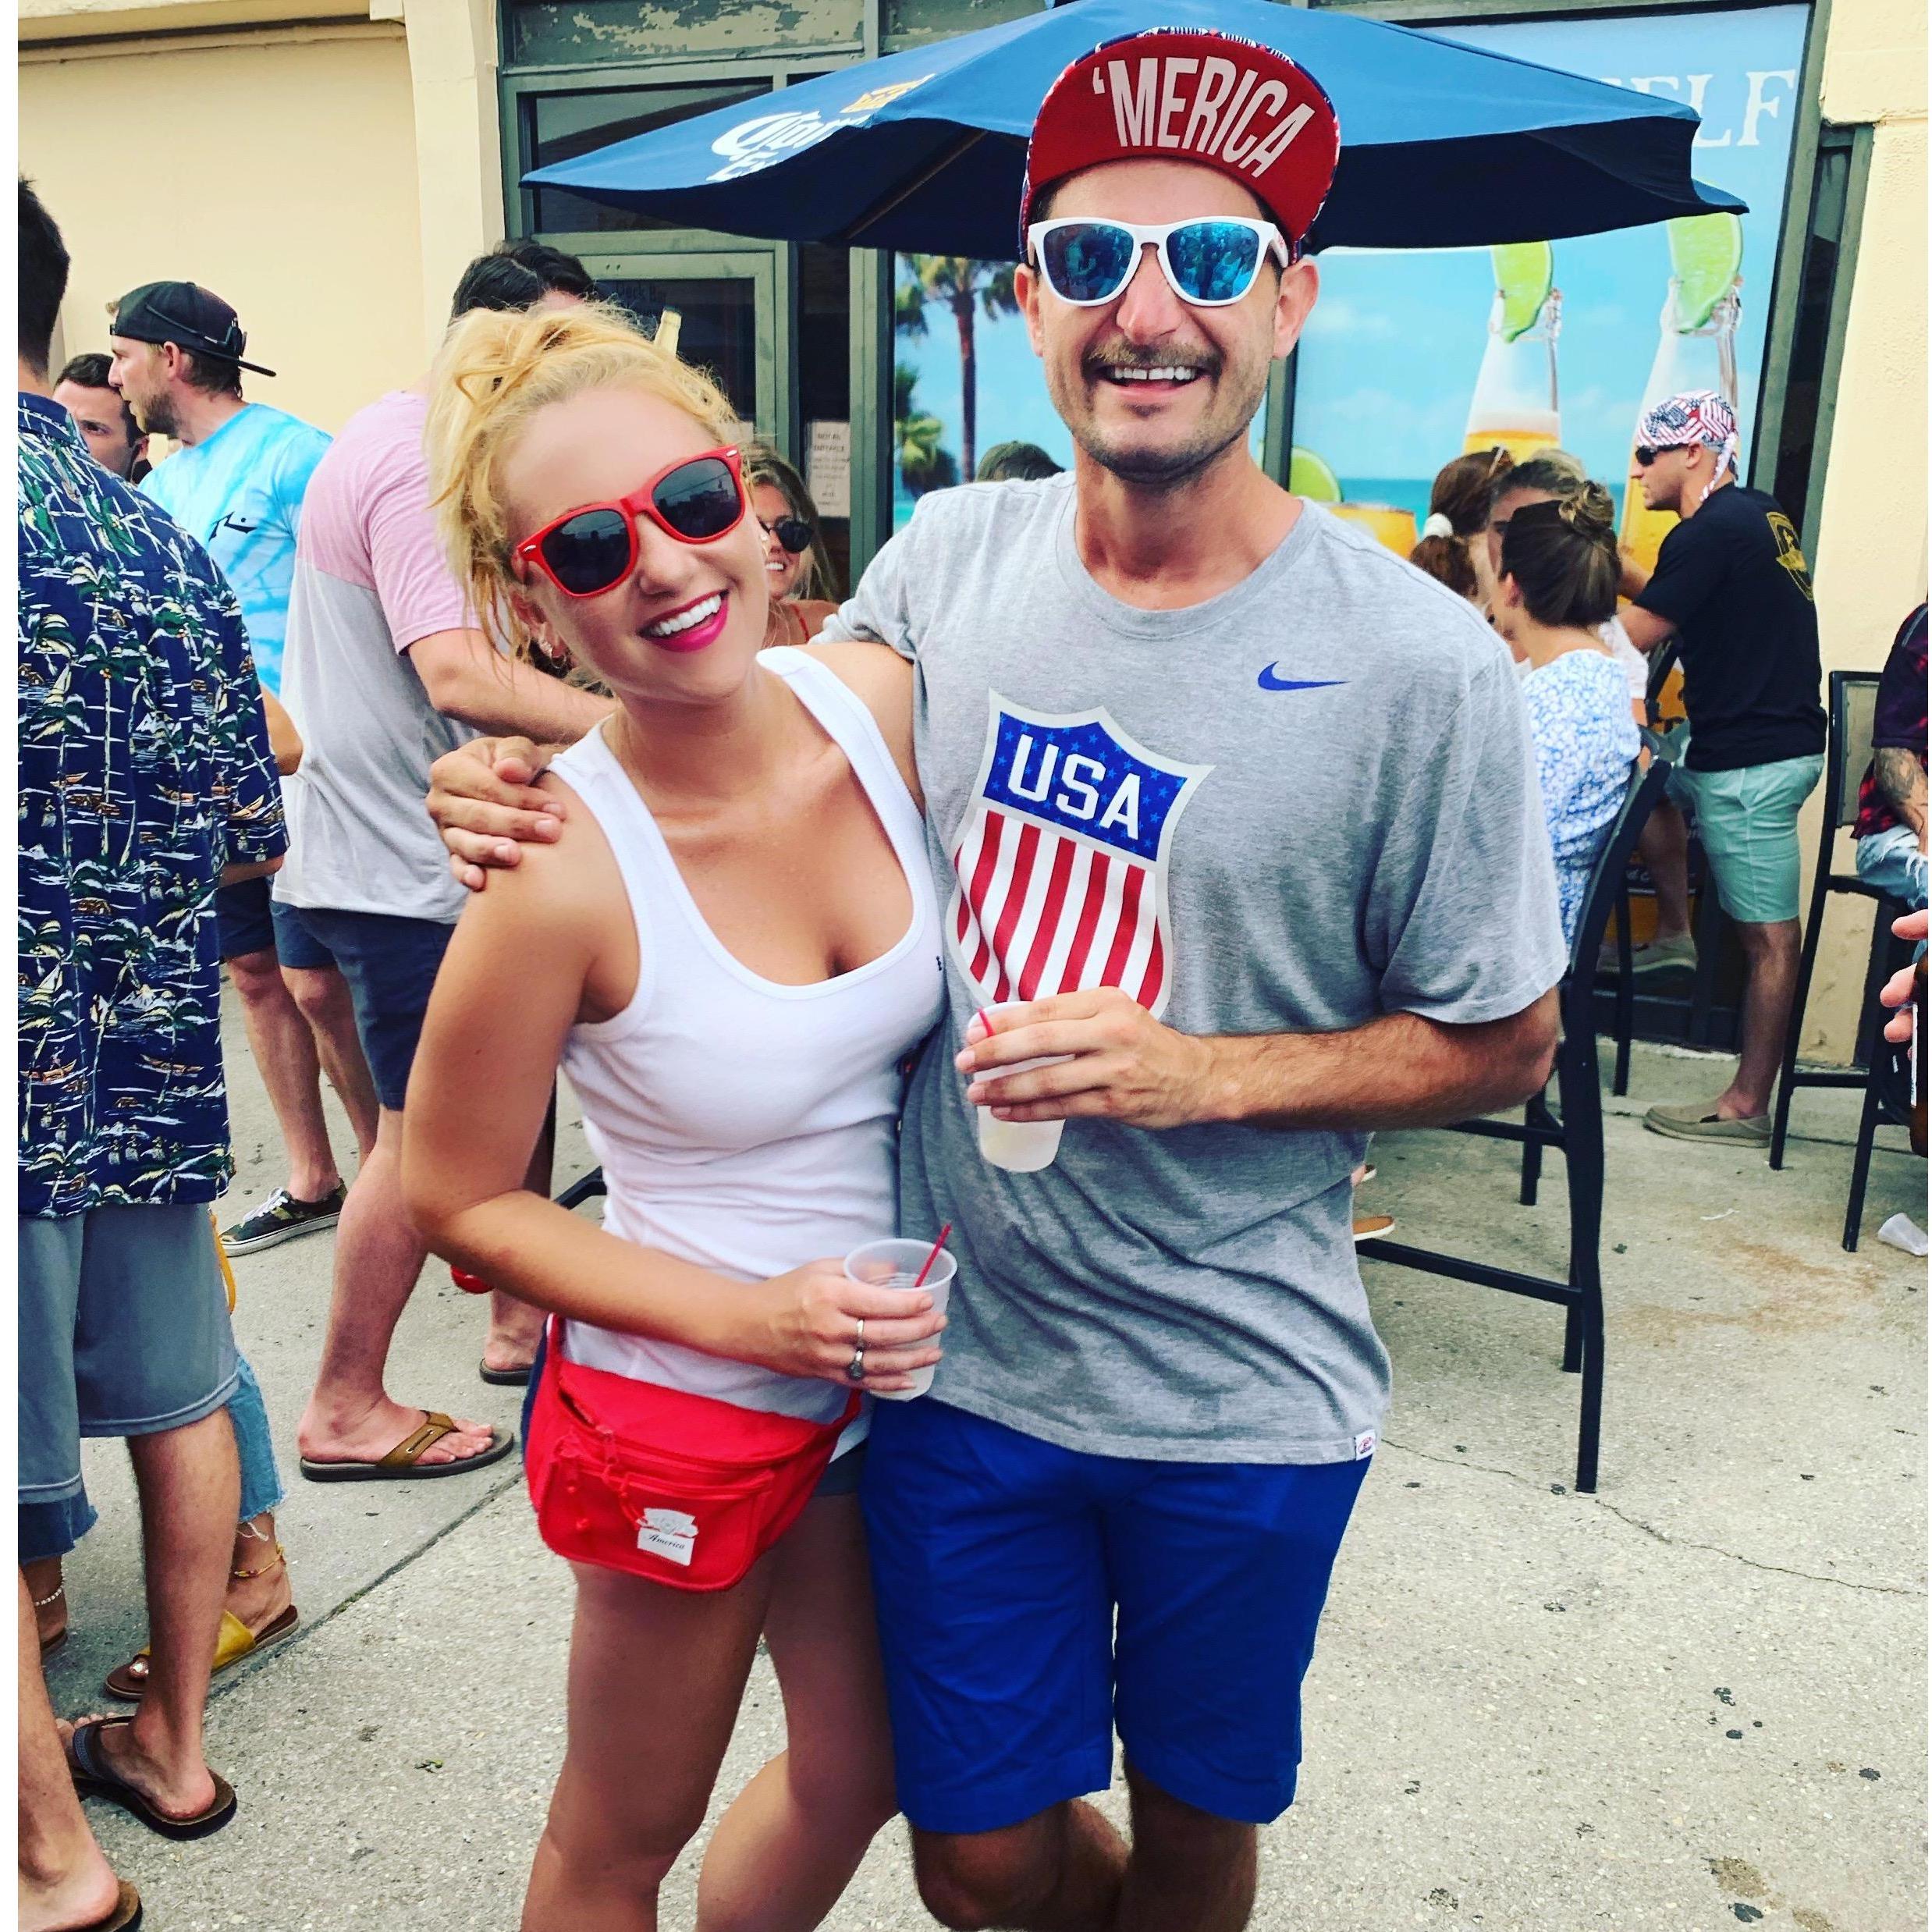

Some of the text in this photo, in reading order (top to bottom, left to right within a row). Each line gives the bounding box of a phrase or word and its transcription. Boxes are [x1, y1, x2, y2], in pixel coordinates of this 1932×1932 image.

[1093, 56, 1316, 178] 'MERICA
[1007, 733, 1141, 840] USA
[648, 1533, 686, 1550] America
